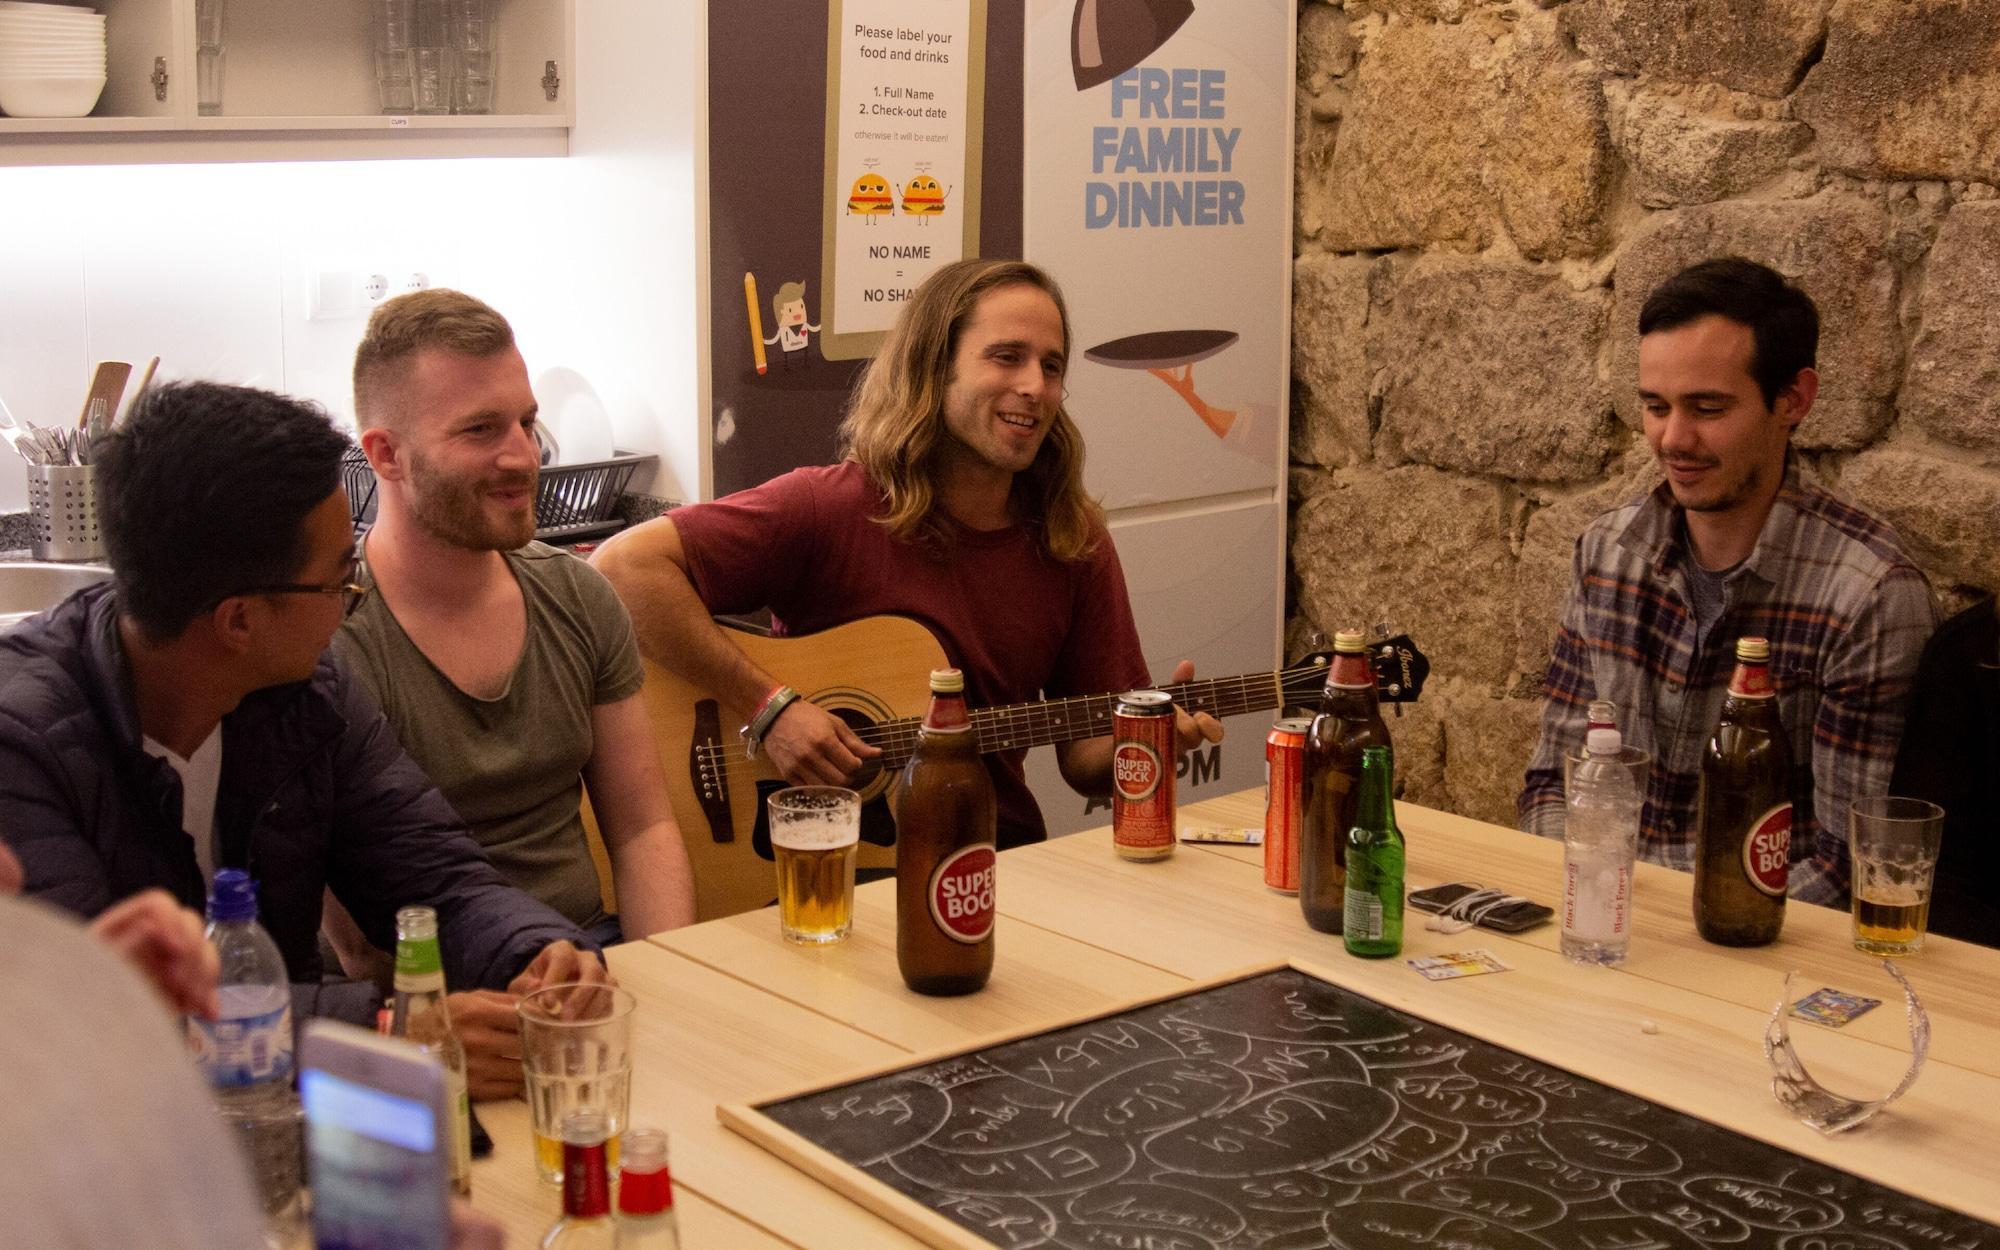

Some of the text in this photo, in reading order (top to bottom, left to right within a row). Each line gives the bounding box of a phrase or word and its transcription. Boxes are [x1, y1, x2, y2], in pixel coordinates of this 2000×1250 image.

[855, 24, 953, 45] Please label your
[860, 45, 949, 64] food and drinks
[873, 86, 935, 100] 1. Full Name
[1111, 67, 1226, 119] FREE
[859, 103, 947, 119] 2. Check-out date
[854, 131, 892, 141] otherwise
[893, 132, 899, 141] it
[900, 132, 913, 141] will
[914, 133, 924, 142] be
[1092, 126, 1242, 174] FAMILY
[1085, 180, 1246, 229] DINNER
[869, 246, 931, 259] NO NAME
[864, 289, 914, 302] NO SHA
[1116, 757, 1151, 772] SUPER
[1117, 769, 1150, 783] BOCK
[1760, 846, 1790, 873] BOC
[1492, 1063, 1590, 1098] STAFF
